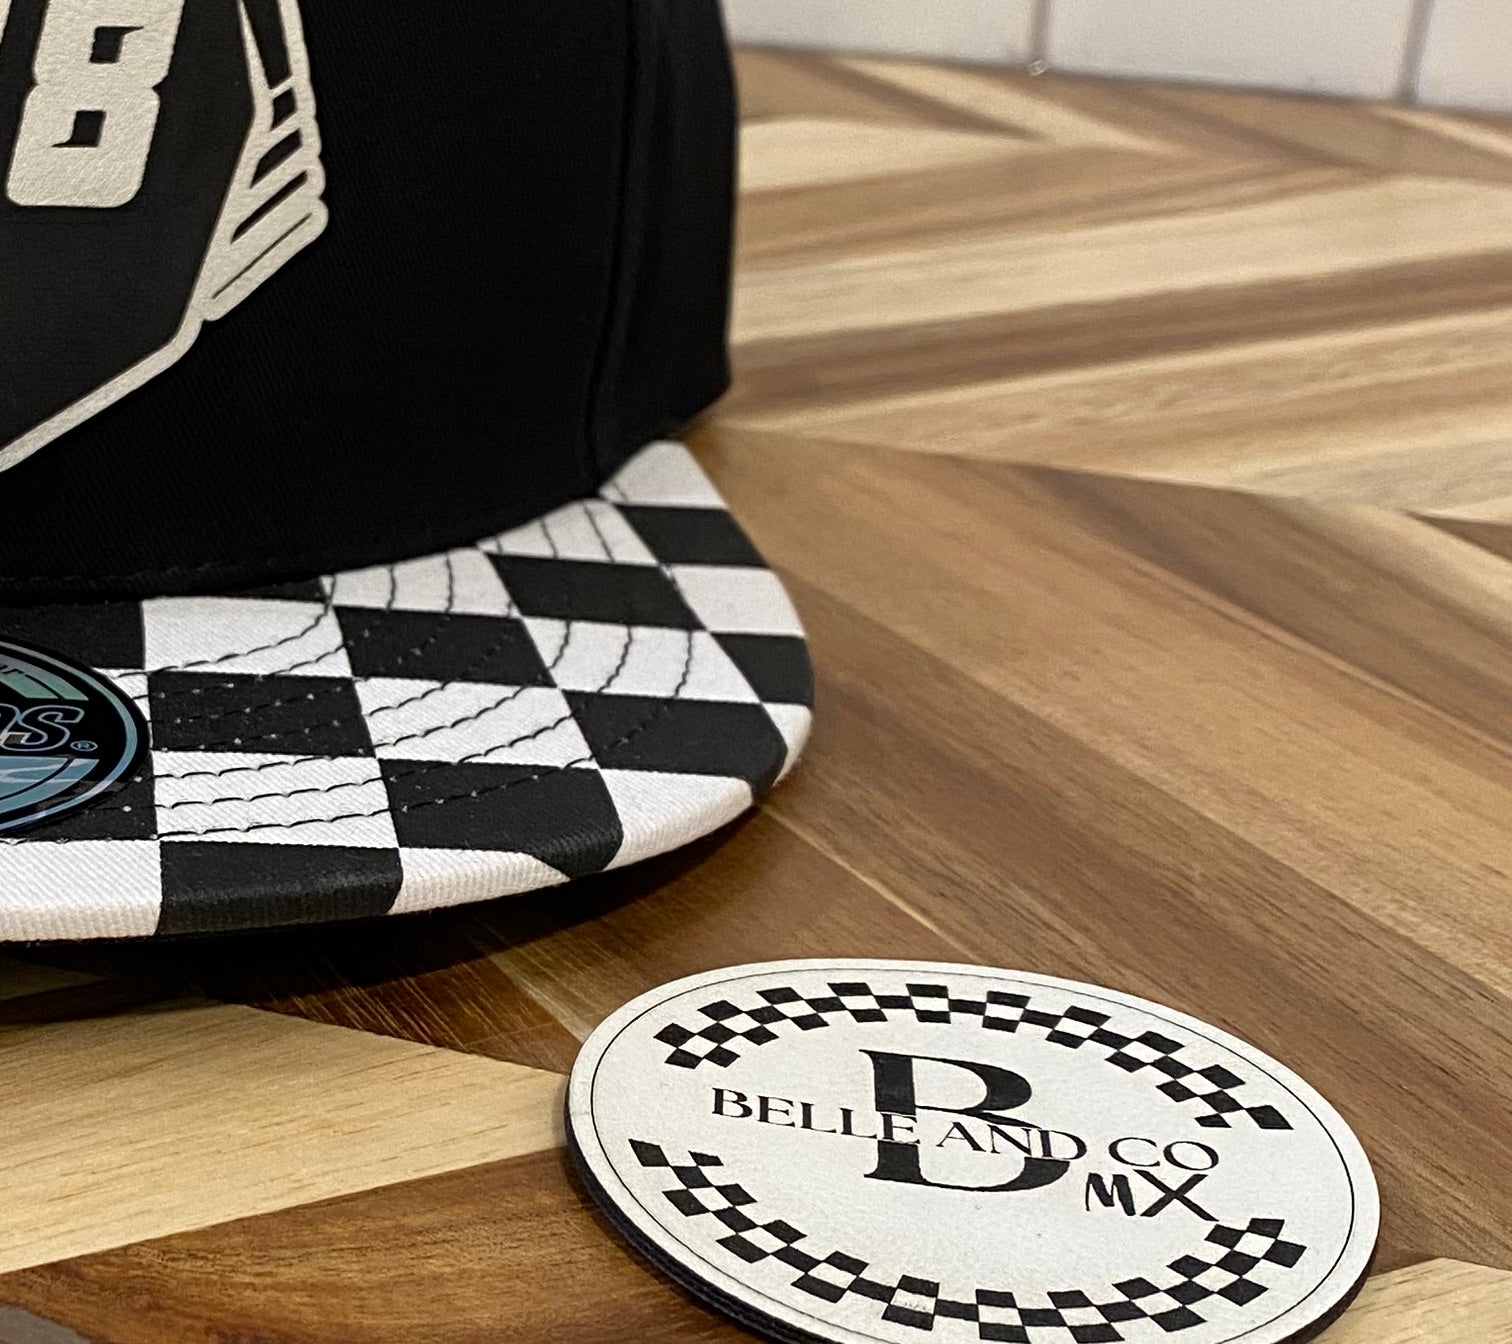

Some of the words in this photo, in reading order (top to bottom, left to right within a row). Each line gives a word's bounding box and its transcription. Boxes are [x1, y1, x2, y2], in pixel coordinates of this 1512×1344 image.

[711, 1087, 919, 1143] BELLE
[937, 1120, 1088, 1162] AND
[1108, 1136, 1220, 1171] CO
[859, 1049, 1071, 1192] B
[1085, 1170, 1219, 1222] MX
